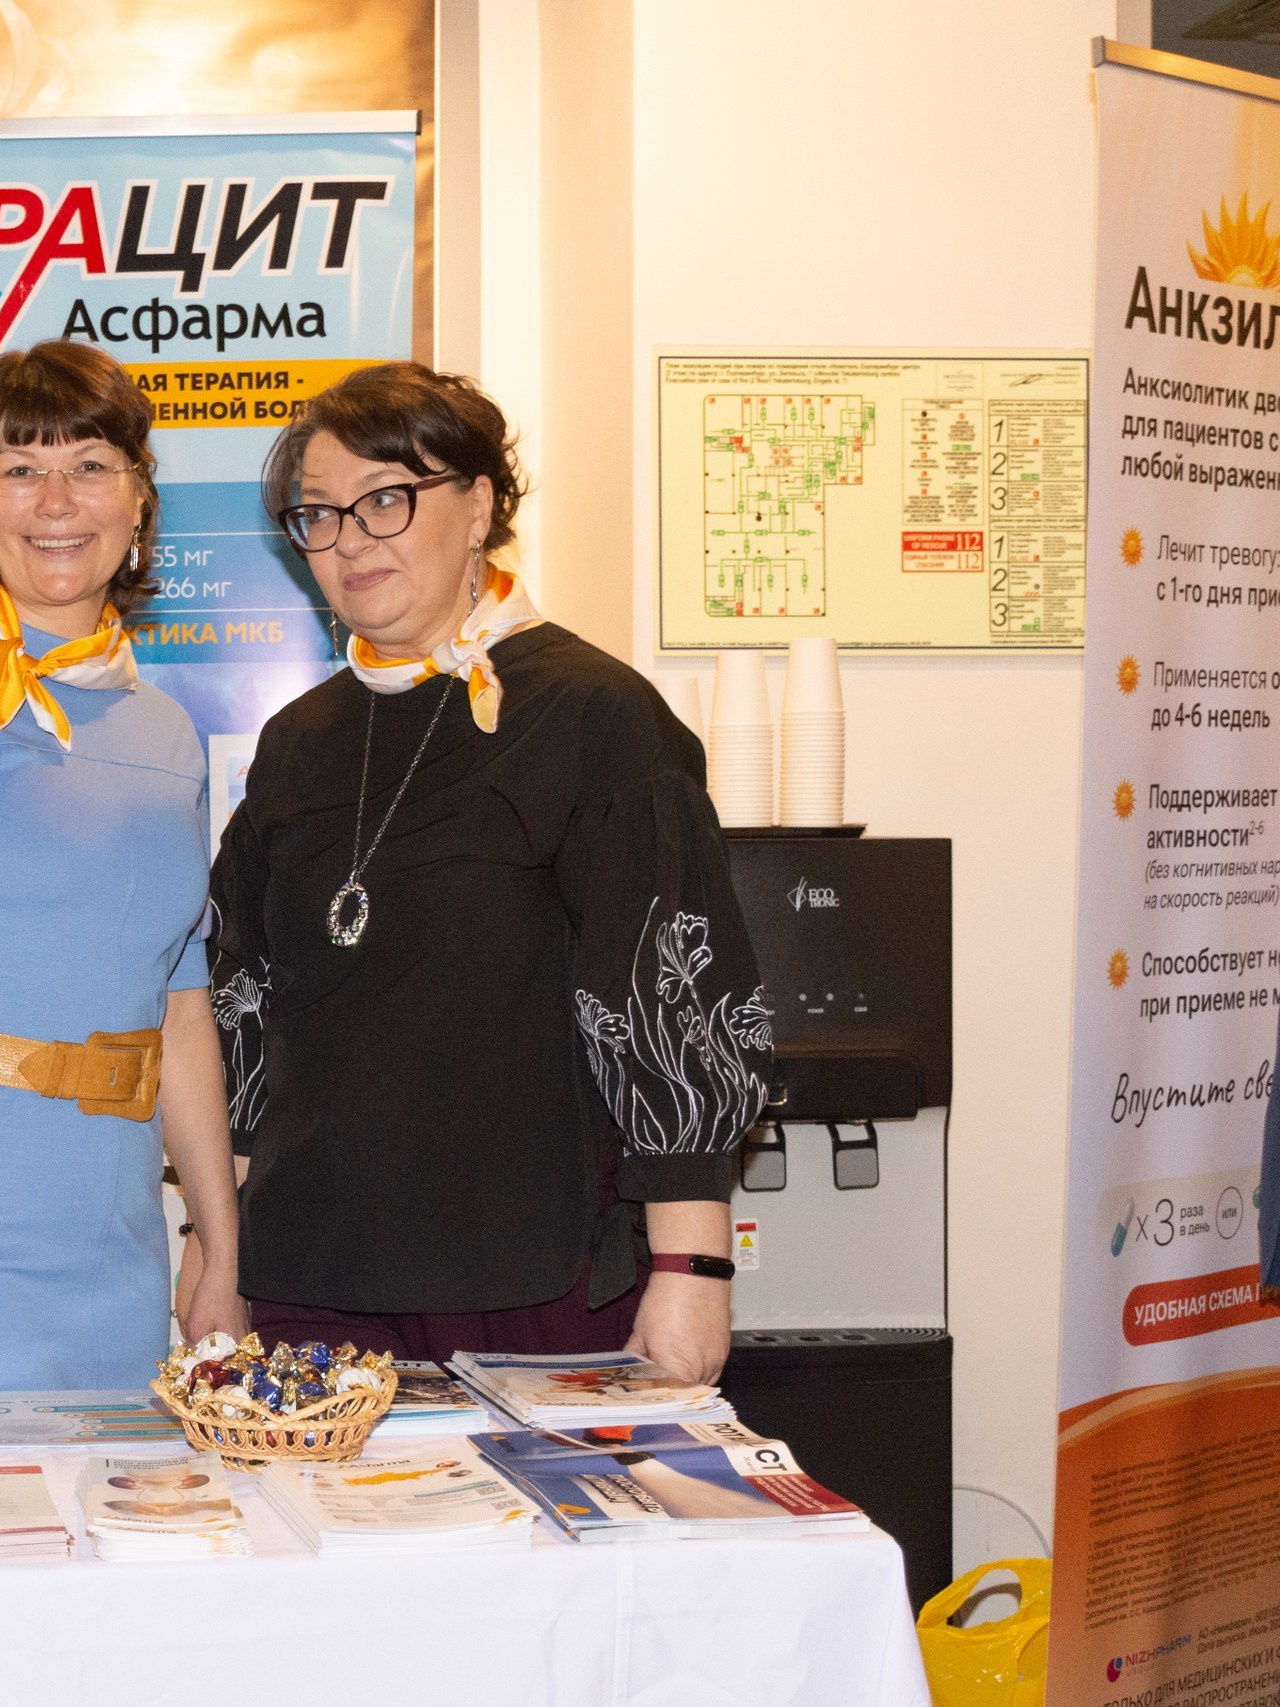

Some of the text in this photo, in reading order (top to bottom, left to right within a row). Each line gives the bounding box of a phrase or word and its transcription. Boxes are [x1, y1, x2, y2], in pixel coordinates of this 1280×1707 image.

[63, 296, 327, 354] Асфарма
[175, 371, 289, 391] ТЕРАПИЯ
[1122, 367, 1248, 410] Анксиолитик
[254, 400, 306, 420] БОЛ
[1122, 413, 1279, 452] для пациентов с
[1121, 450, 1184, 482] любой
[956, 533, 982, 550] 112
[1157, 535, 1206, 565] Лечит
[184, 551, 214, 567] мг
[957, 553, 980, 569] 112
[203, 582, 232, 598] мг
[1157, 582, 1166, 600] с
[1170, 577, 1202, 602] 1-го
[1207, 585, 1242, 609] дня
[128, 621, 285, 646] КТИКА МКБ
[1153, 661, 1267, 693] Применяется
[1151, 703, 1271, 732] до 4-6 недель
[1149, 784, 1278, 814] Поддерживает
[1144, 859, 1170, 884] (без
[1173, 860, 1258, 880] когнитивных
[808, 888, 835, 900] ECO
[1144, 892, 1158, 909] на
[1160, 889, 1223, 912] скорость
[1141, 948, 1264, 978] Способствует
[1140, 994, 1170, 1023] при
[1176, 989, 1245, 1019] приеме
[1248, 985, 1268, 1007] не
[1111, 1072, 1234, 1128] Впустите
[1154, 1198, 1175, 1247] 3
[1180, 1204, 1204, 1221] раза
[1221, 1207, 1238, 1220] или
[1179, 1220, 1210, 1236] в день
[1134, 1284, 1252, 1326] УДОБНАЯ СХЕМА
[1125, 1634, 1193, 1666] NIZHPHARM
[1103, 1648, 1274, 1707] ЛЬКО ДЛЯ МЕДИЦИНСКИХ И
